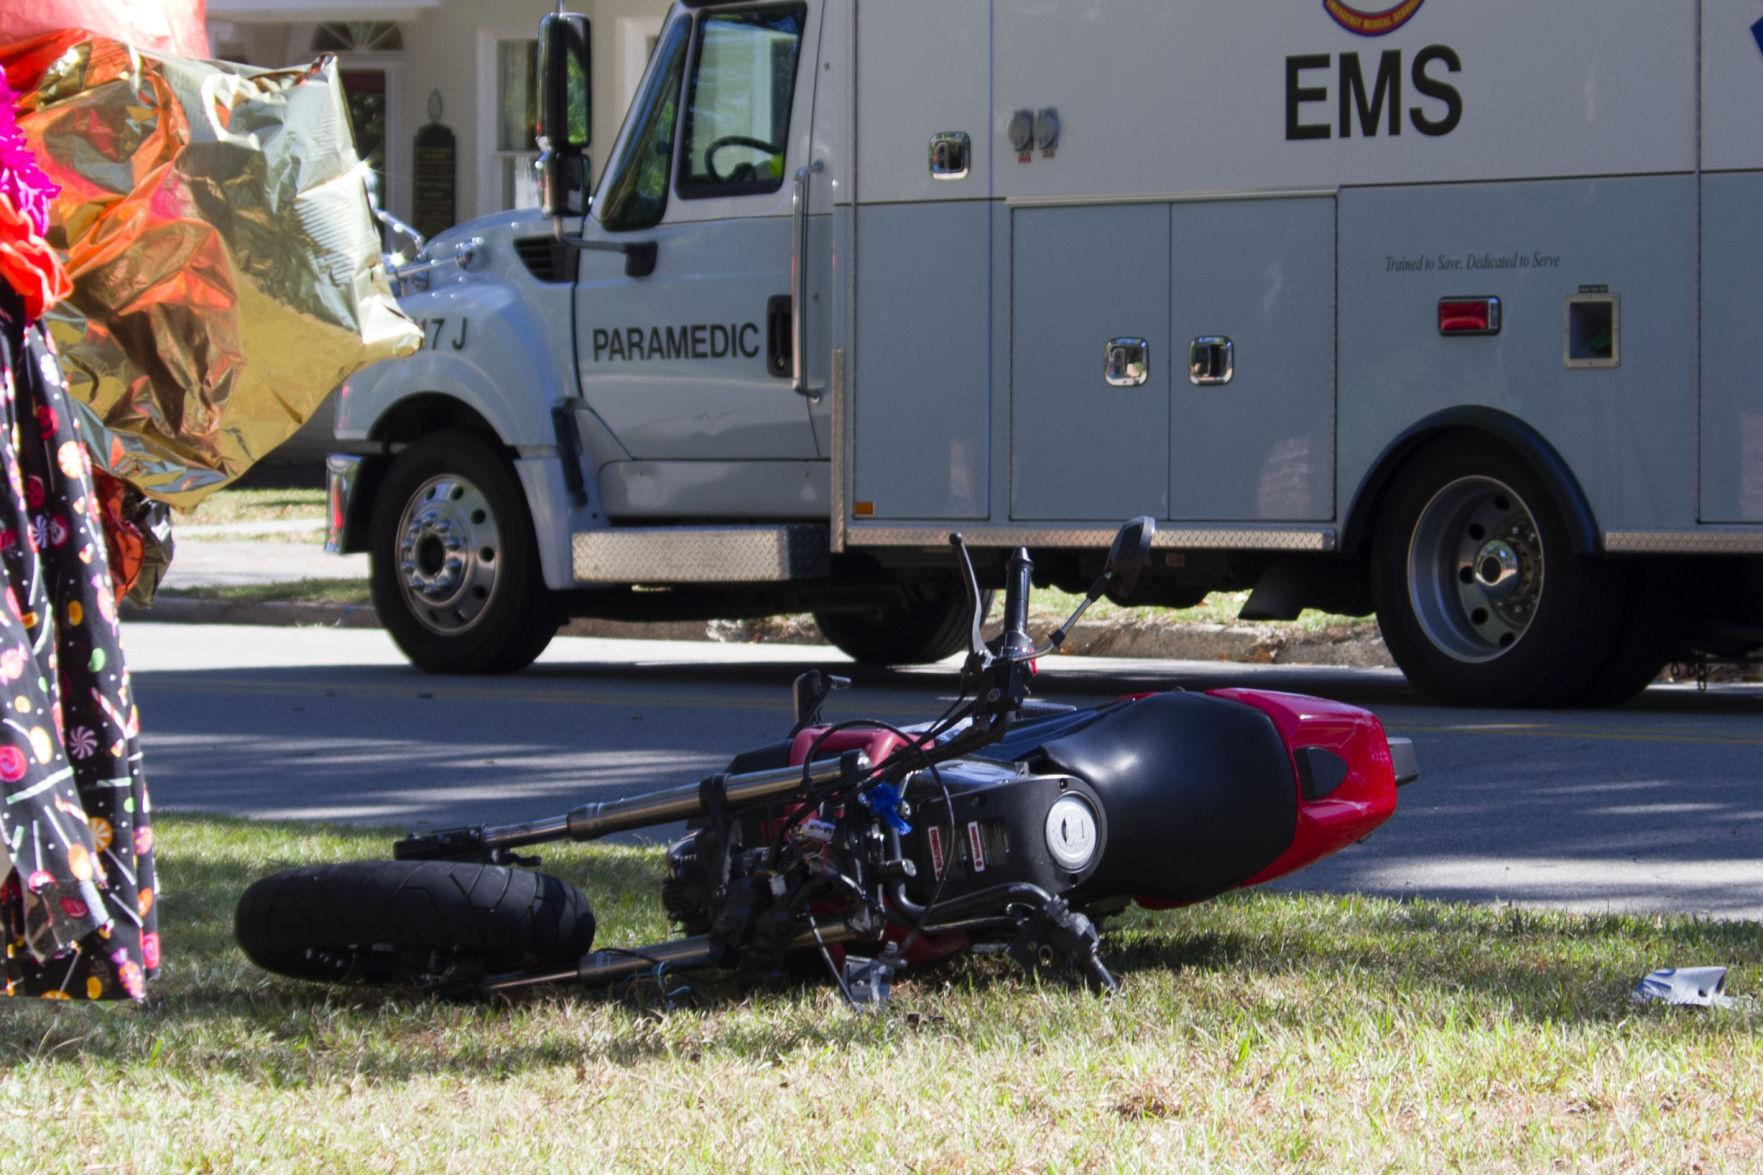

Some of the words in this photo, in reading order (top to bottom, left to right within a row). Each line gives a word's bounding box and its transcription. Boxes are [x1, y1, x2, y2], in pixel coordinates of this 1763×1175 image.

[1285, 43, 1463, 141] EMS
[1385, 254, 1424, 272] Trained
[1425, 256, 1436, 271] to
[1465, 252, 1518, 270] Dedicated
[1519, 254, 1530, 269] to
[1531, 251, 1562, 269] Serve
[452, 317, 468, 350] J
[592, 321, 760, 362] PARAMEDIC
